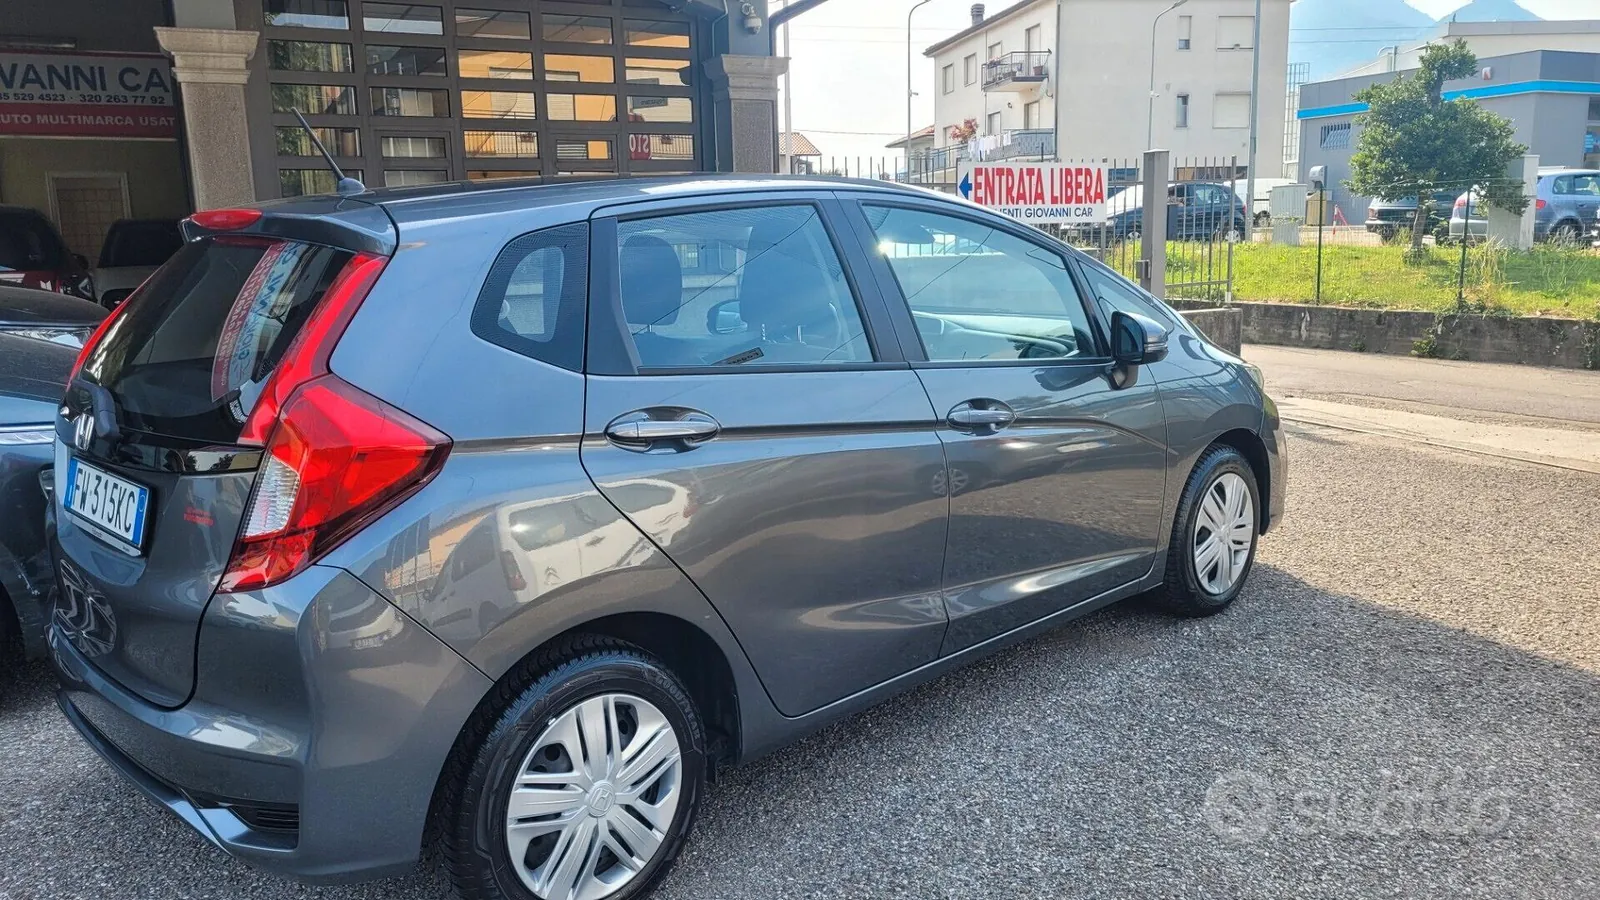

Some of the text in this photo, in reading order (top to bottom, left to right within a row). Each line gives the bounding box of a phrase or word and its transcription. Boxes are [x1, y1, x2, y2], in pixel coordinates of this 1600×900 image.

[118, 66, 170, 94] CA
[13, 93, 34, 101] 529
[38, 93, 66, 102] 4523
[79, 94, 102, 103] 320
[106, 95, 128, 104] 263
[132, 95, 146, 104] 77
[150, 96, 165, 105] 92
[0, 113, 32, 125] UTO
[36, 114, 134, 127] MULTIMARCA
[973, 167, 1105, 206] ENTRATA LIBERA
[997, 207, 1093, 218] ENTI GIOVANNI CAR
